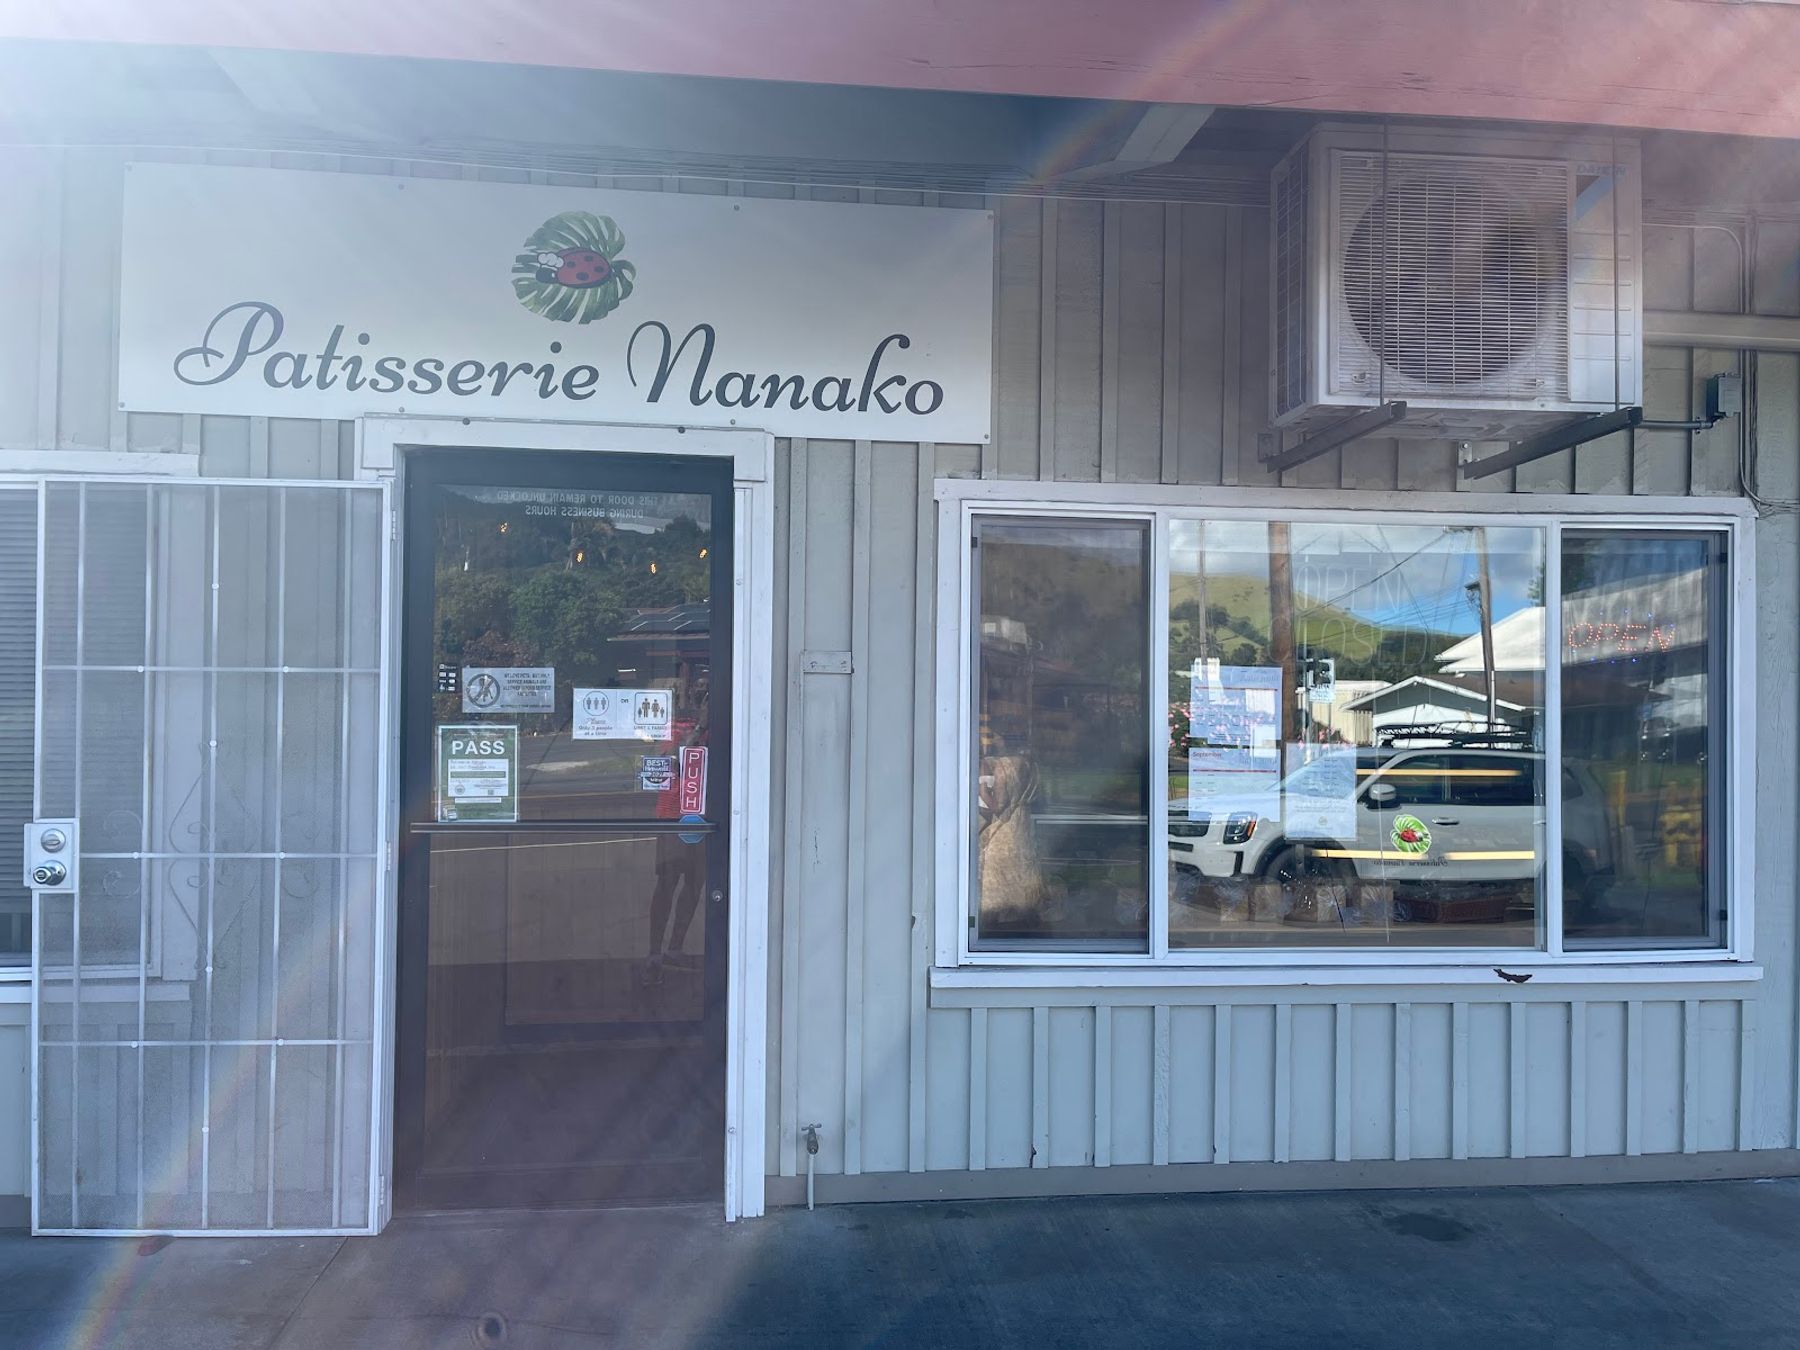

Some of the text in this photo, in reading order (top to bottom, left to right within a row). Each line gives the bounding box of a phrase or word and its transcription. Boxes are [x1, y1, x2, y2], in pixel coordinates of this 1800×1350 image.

[174, 301, 944, 416] Patisserie Nanako
[1296, 561, 1401, 614] OPEN
[1569, 622, 1676, 652] OPEN
[451, 740, 505, 755] PASS
[647, 759, 665, 767] BEST
[686, 752, 700, 808] PUSH
